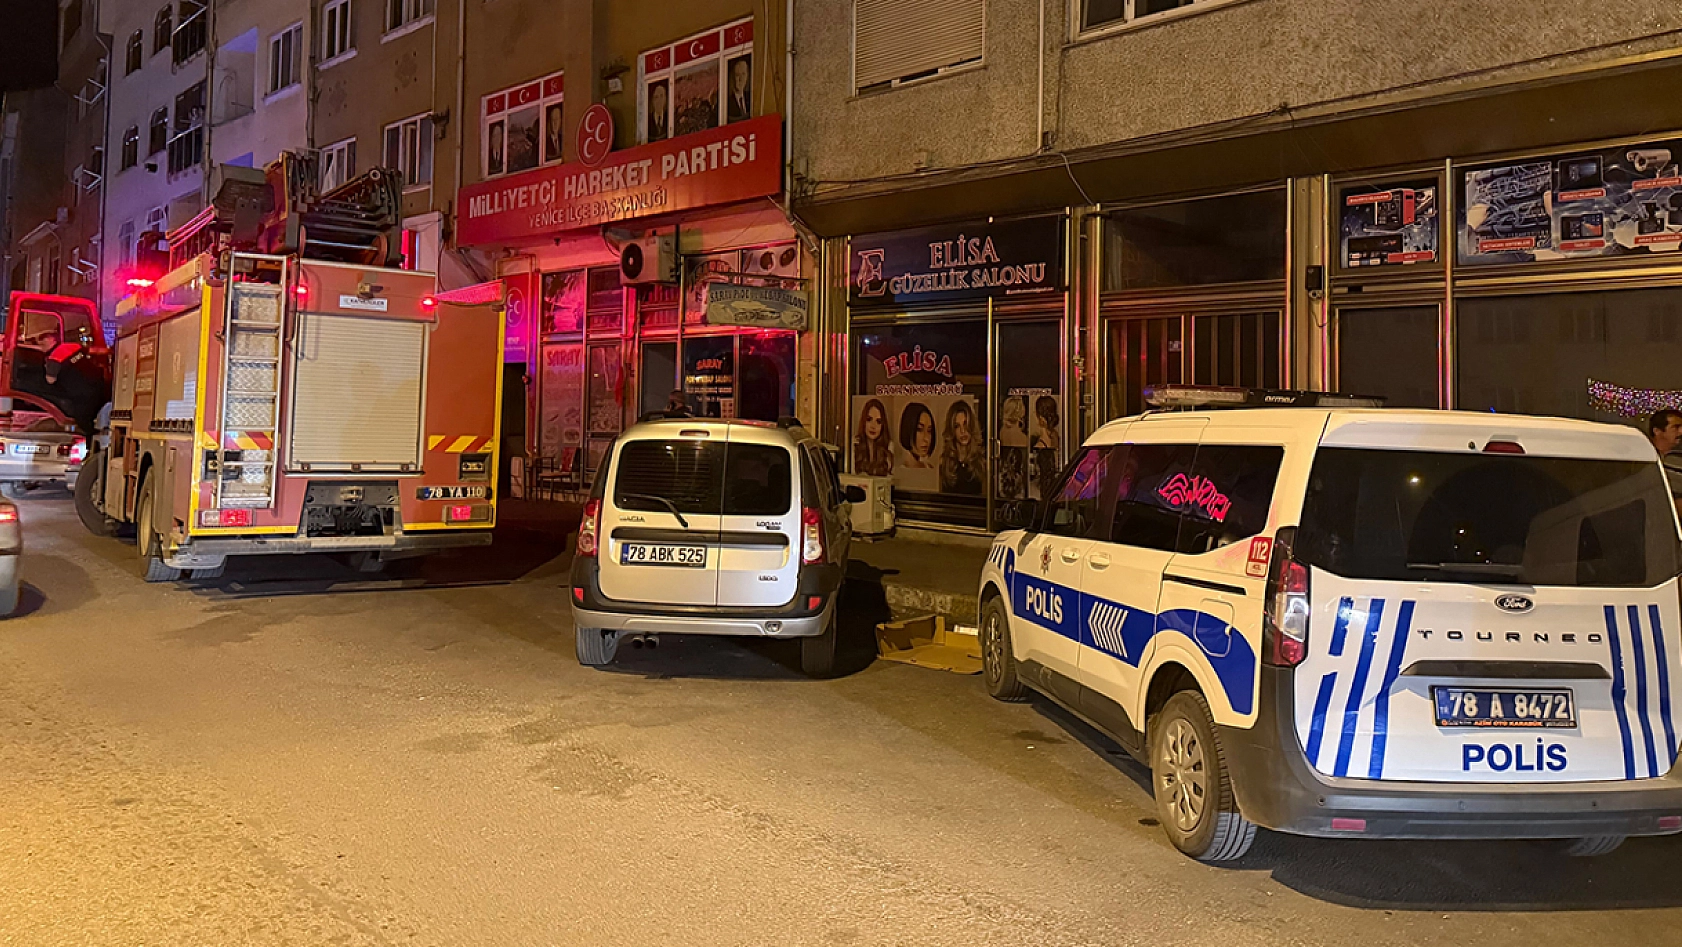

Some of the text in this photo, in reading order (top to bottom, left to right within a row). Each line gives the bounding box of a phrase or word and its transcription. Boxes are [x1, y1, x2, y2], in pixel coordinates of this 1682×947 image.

[564, 159, 652, 200] HAREKET
[928, 233, 1000, 268] ELİSA
[889, 262, 1046, 294] GÜZELLİK SALONU
[883, 344, 953, 378] ELİSA
[429, 486, 483, 498] 78 YA 110
[629, 546, 703, 562] 78 ABK 525
[1252, 540, 1269, 560] 112
[1025, 584, 1063, 625] POLİS
[1417, 630, 1602, 643] TOURNEO
[1449, 692, 1479, 718] 78
[1490, 692, 1504, 719] A
[1514, 693, 1568, 719] 8472
[1462, 737, 1567, 771] POLİS
